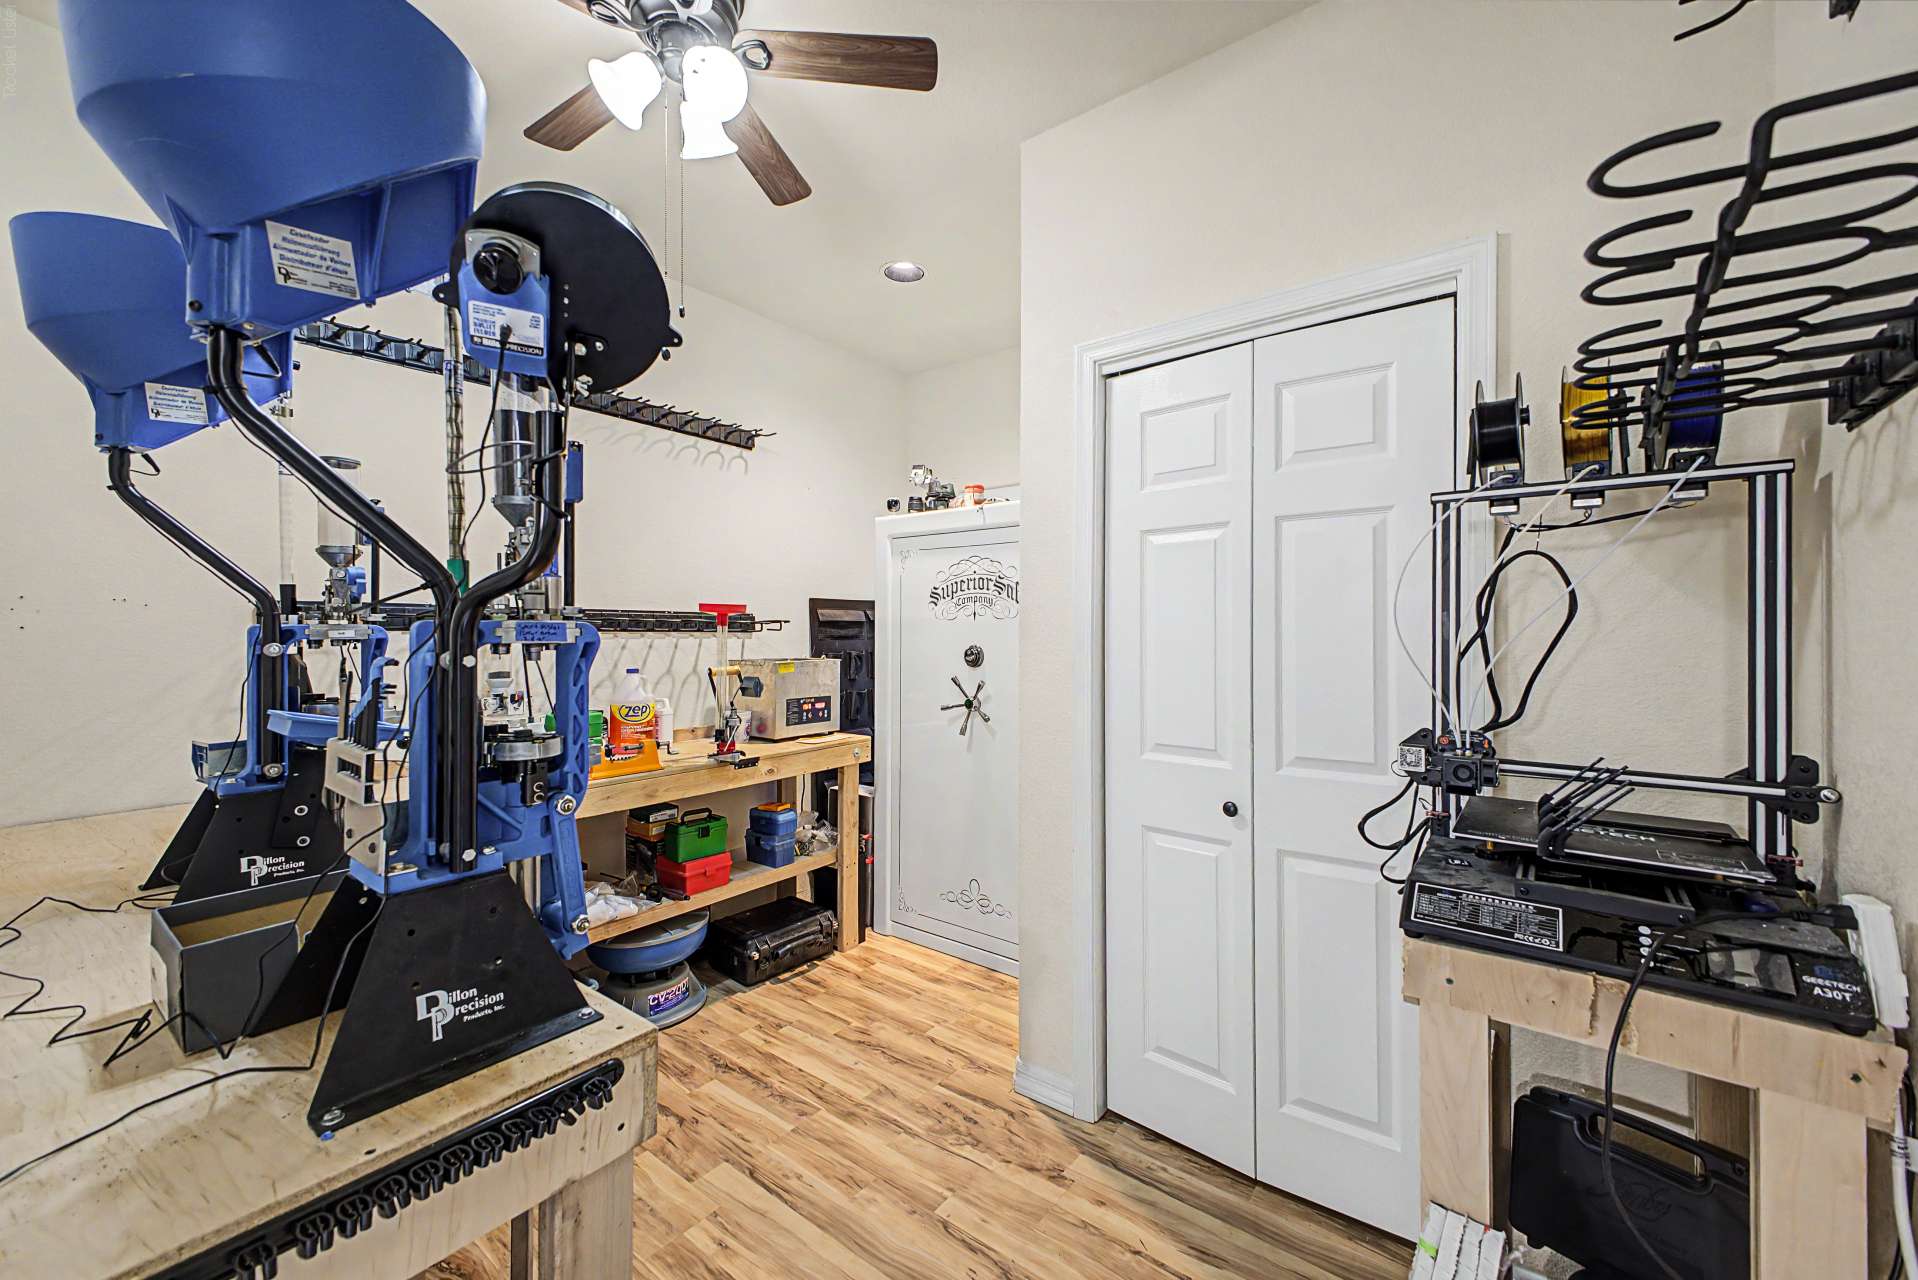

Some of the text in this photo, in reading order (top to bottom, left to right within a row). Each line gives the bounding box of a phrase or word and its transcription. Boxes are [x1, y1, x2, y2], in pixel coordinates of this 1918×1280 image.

[240, 855, 285, 873] Dillon
[1813, 986, 1853, 1002] A30T
[416, 988, 478, 1022] Dillon
